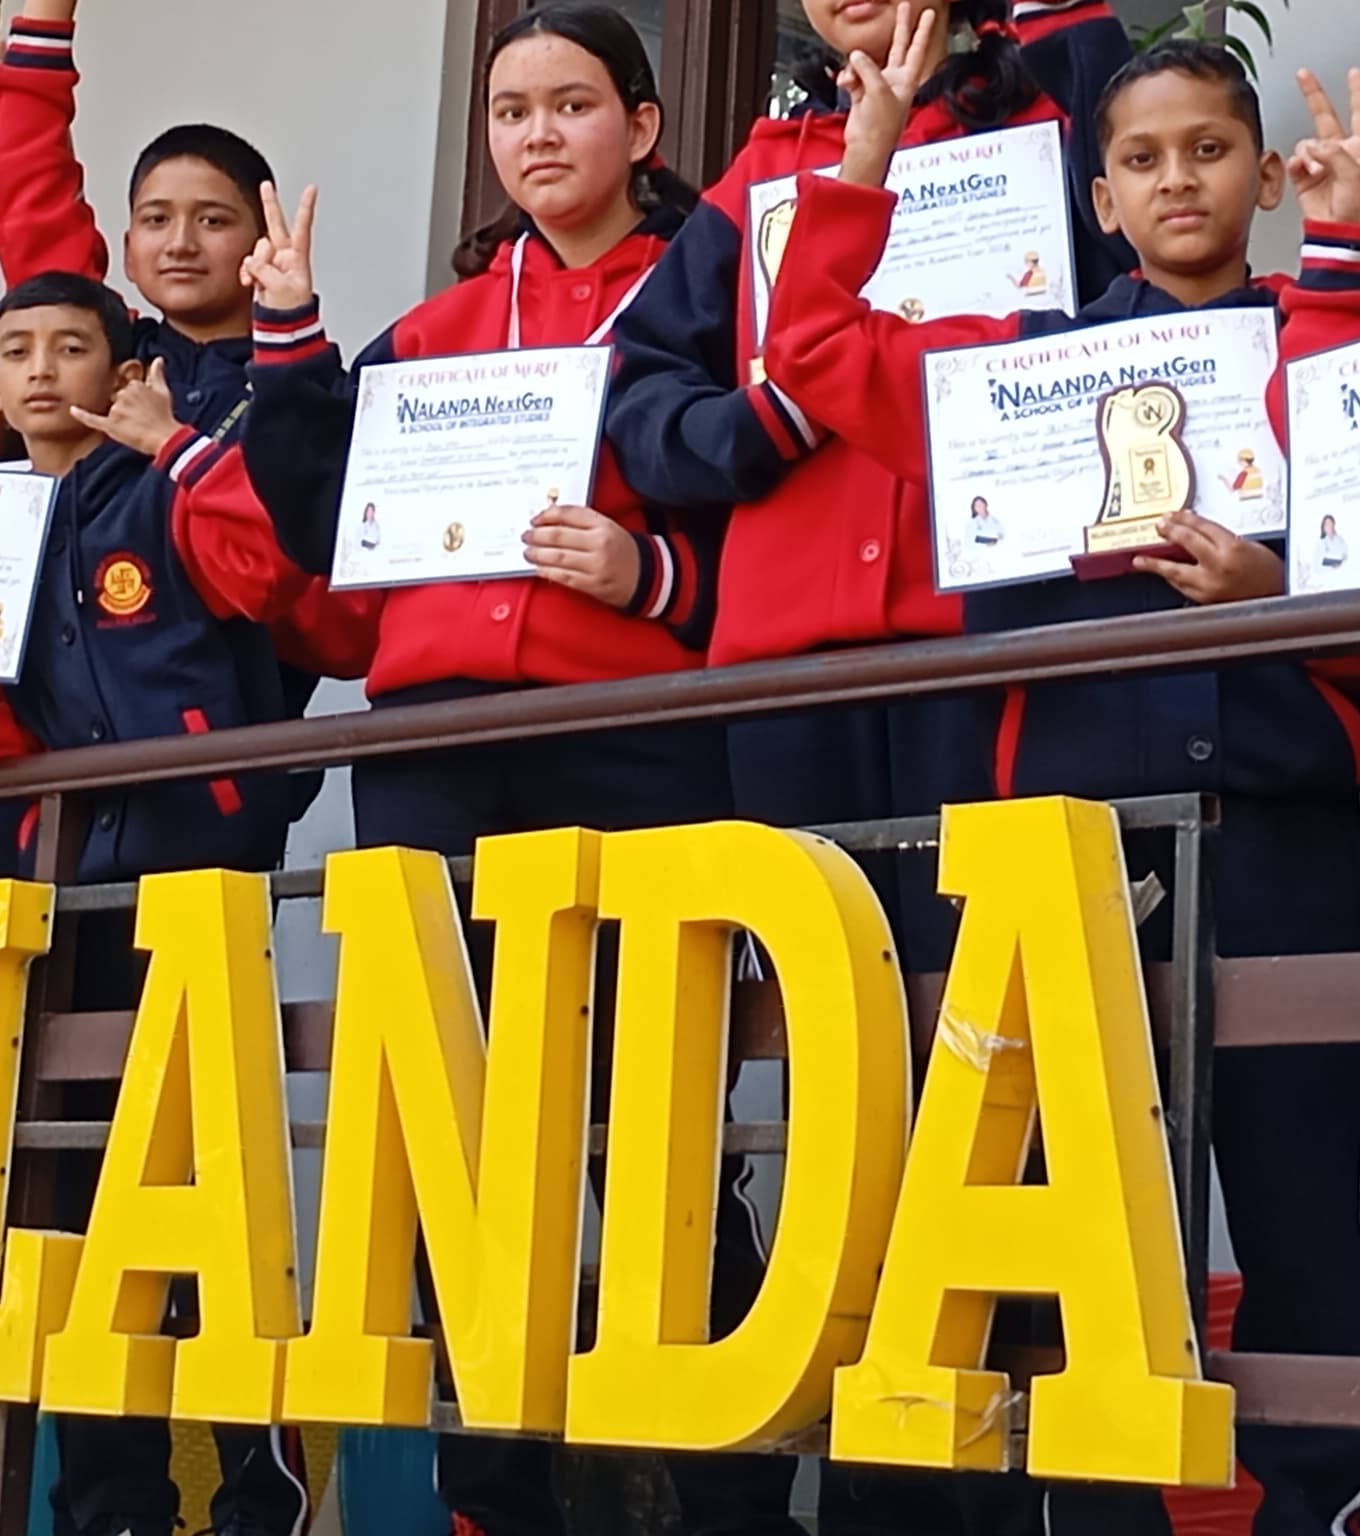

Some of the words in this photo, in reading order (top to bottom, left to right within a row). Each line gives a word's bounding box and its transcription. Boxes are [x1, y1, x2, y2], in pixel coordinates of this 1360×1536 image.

[920, 173, 1008, 202] NextGen
[985, 340, 1109, 374] CERTIFICATE
[997, 370, 1113, 411] NALANDA
[1119, 356, 1217, 383] NextGen
[1014, 403, 1063, 421] SCHOOL
[1174, 373, 1217, 389] TUDIES
[399, 396, 481, 424] NALANDA
[484, 391, 554, 413] NextGen
